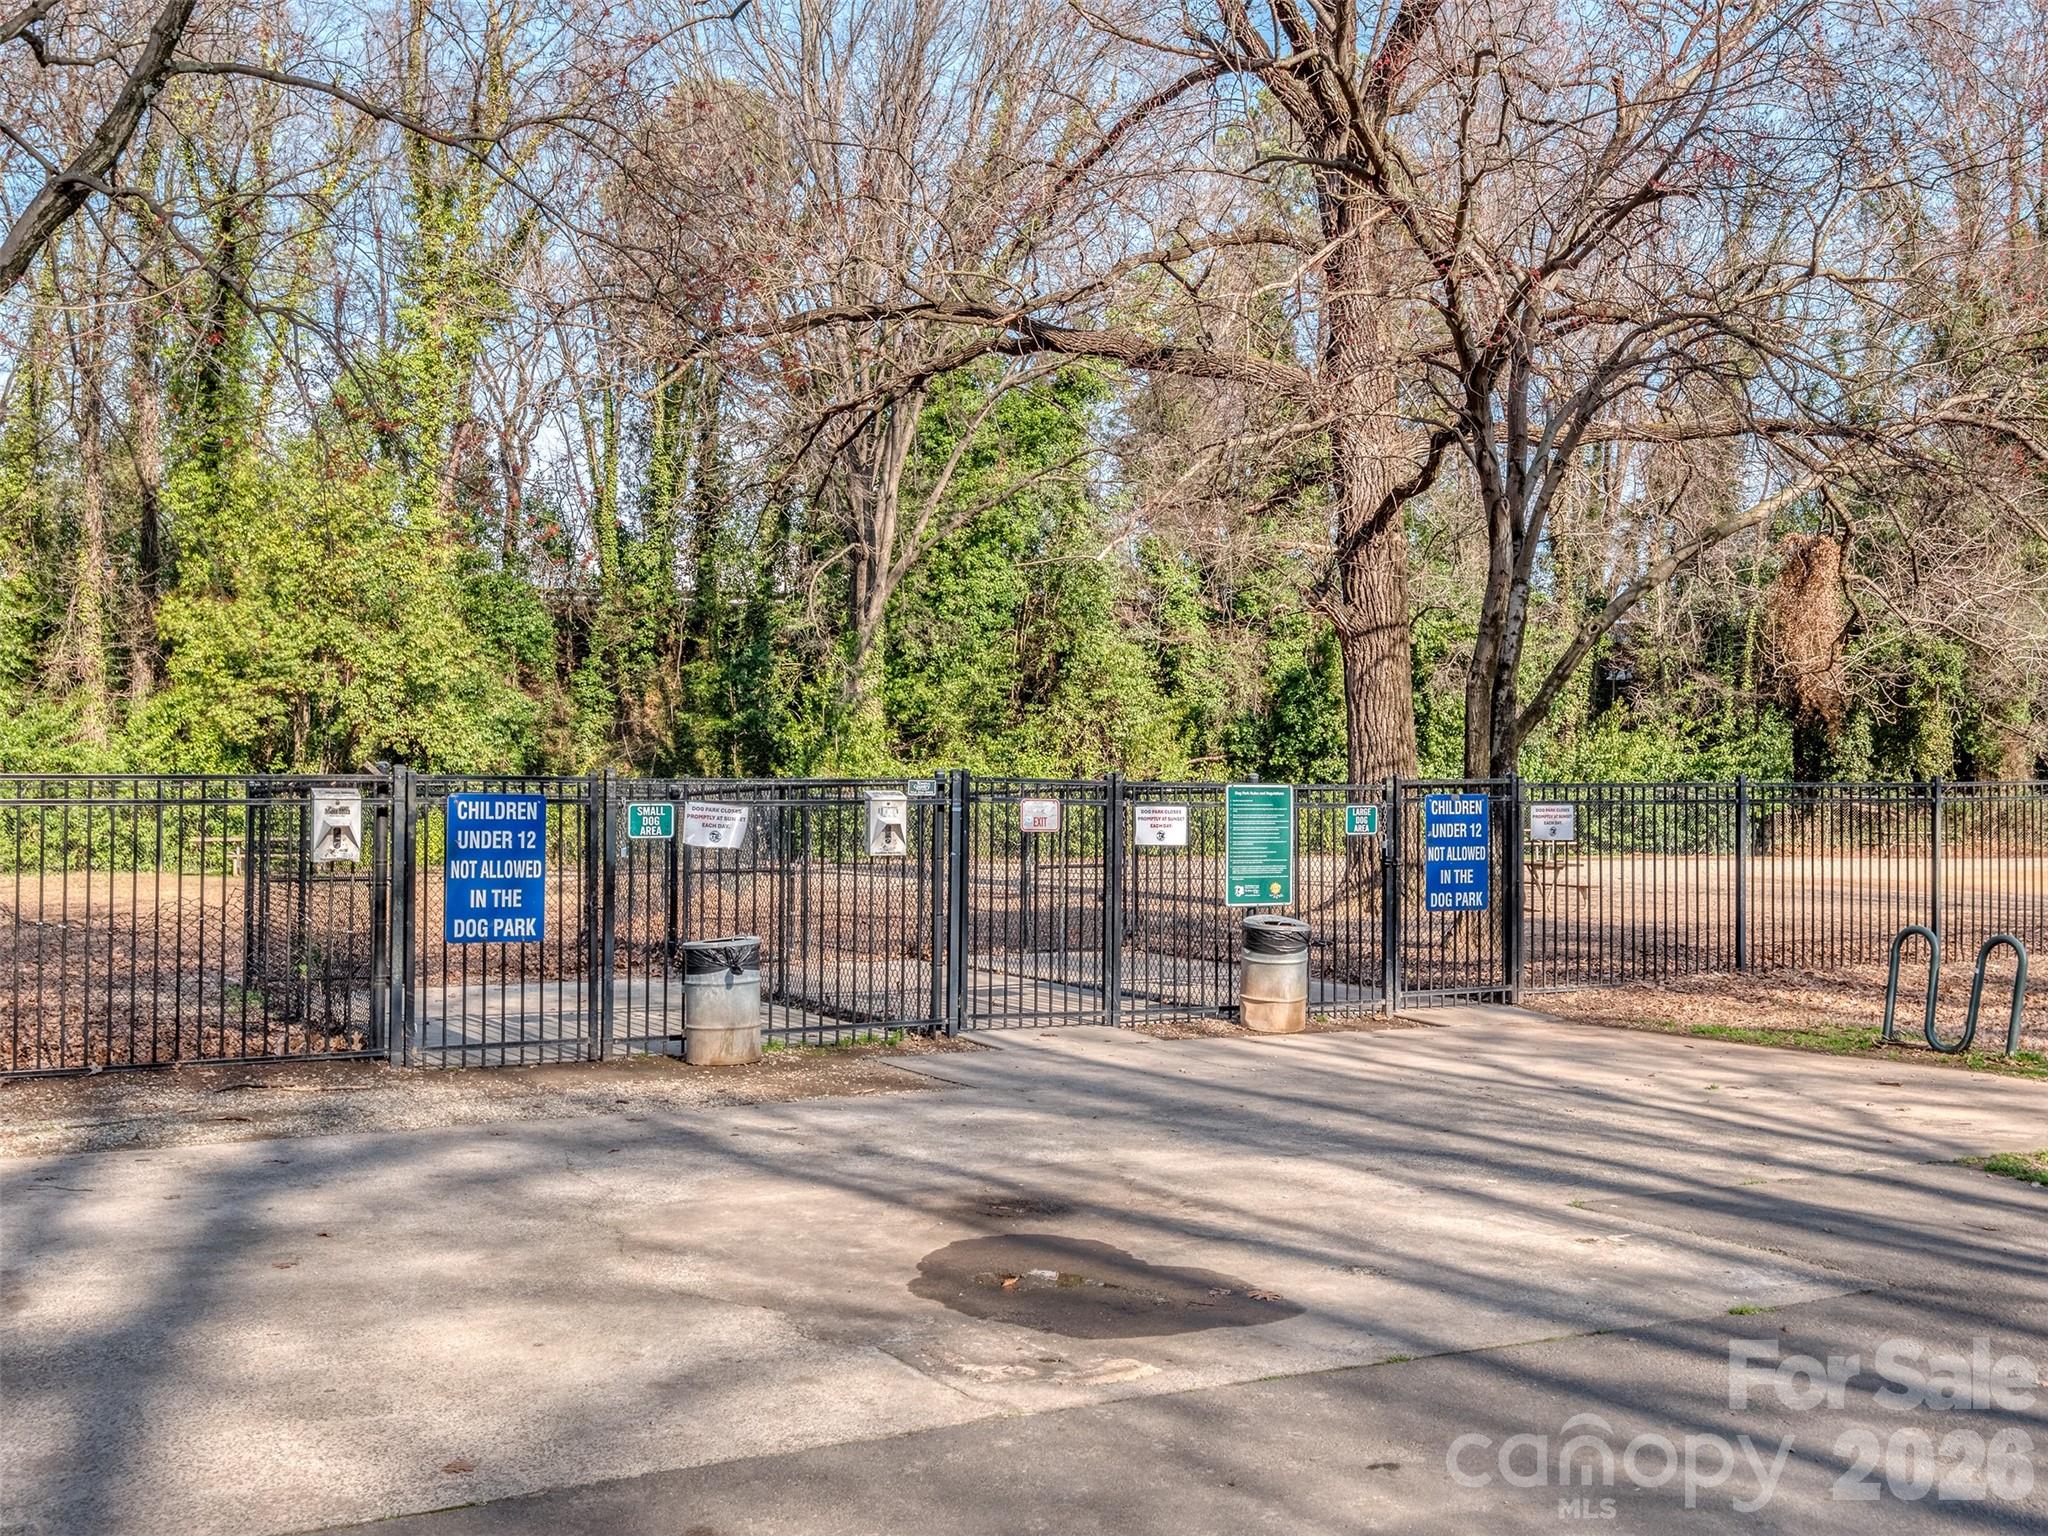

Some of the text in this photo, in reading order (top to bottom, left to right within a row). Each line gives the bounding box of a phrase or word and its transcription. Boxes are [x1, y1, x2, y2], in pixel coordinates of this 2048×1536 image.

[457, 801, 538, 820] CHILDREN
[637, 806, 666, 816] SMALL
[1352, 808, 1371, 816] LARGE
[1431, 800, 1483, 815] CHILDREN
[642, 817, 660, 826] DOG
[1033, 817, 1048, 827] EXIT
[1355, 816, 1368, 825] DOG
[640, 826, 662, 835] AREA
[1354, 824, 1370, 833] AREA
[1432, 823, 1482, 838] UNDER 12
[458, 831, 536, 849] UNDER 12
[1428, 846, 1486, 861] NOT ALLOWED
[450, 860, 542, 879] NOT ALLOWED
[1440, 869, 1474, 884] IN THE
[470, 889, 522, 908] IN THE
[1430, 892, 1483, 907] DOG PARK
[454, 918, 536, 938] DOG PARK
